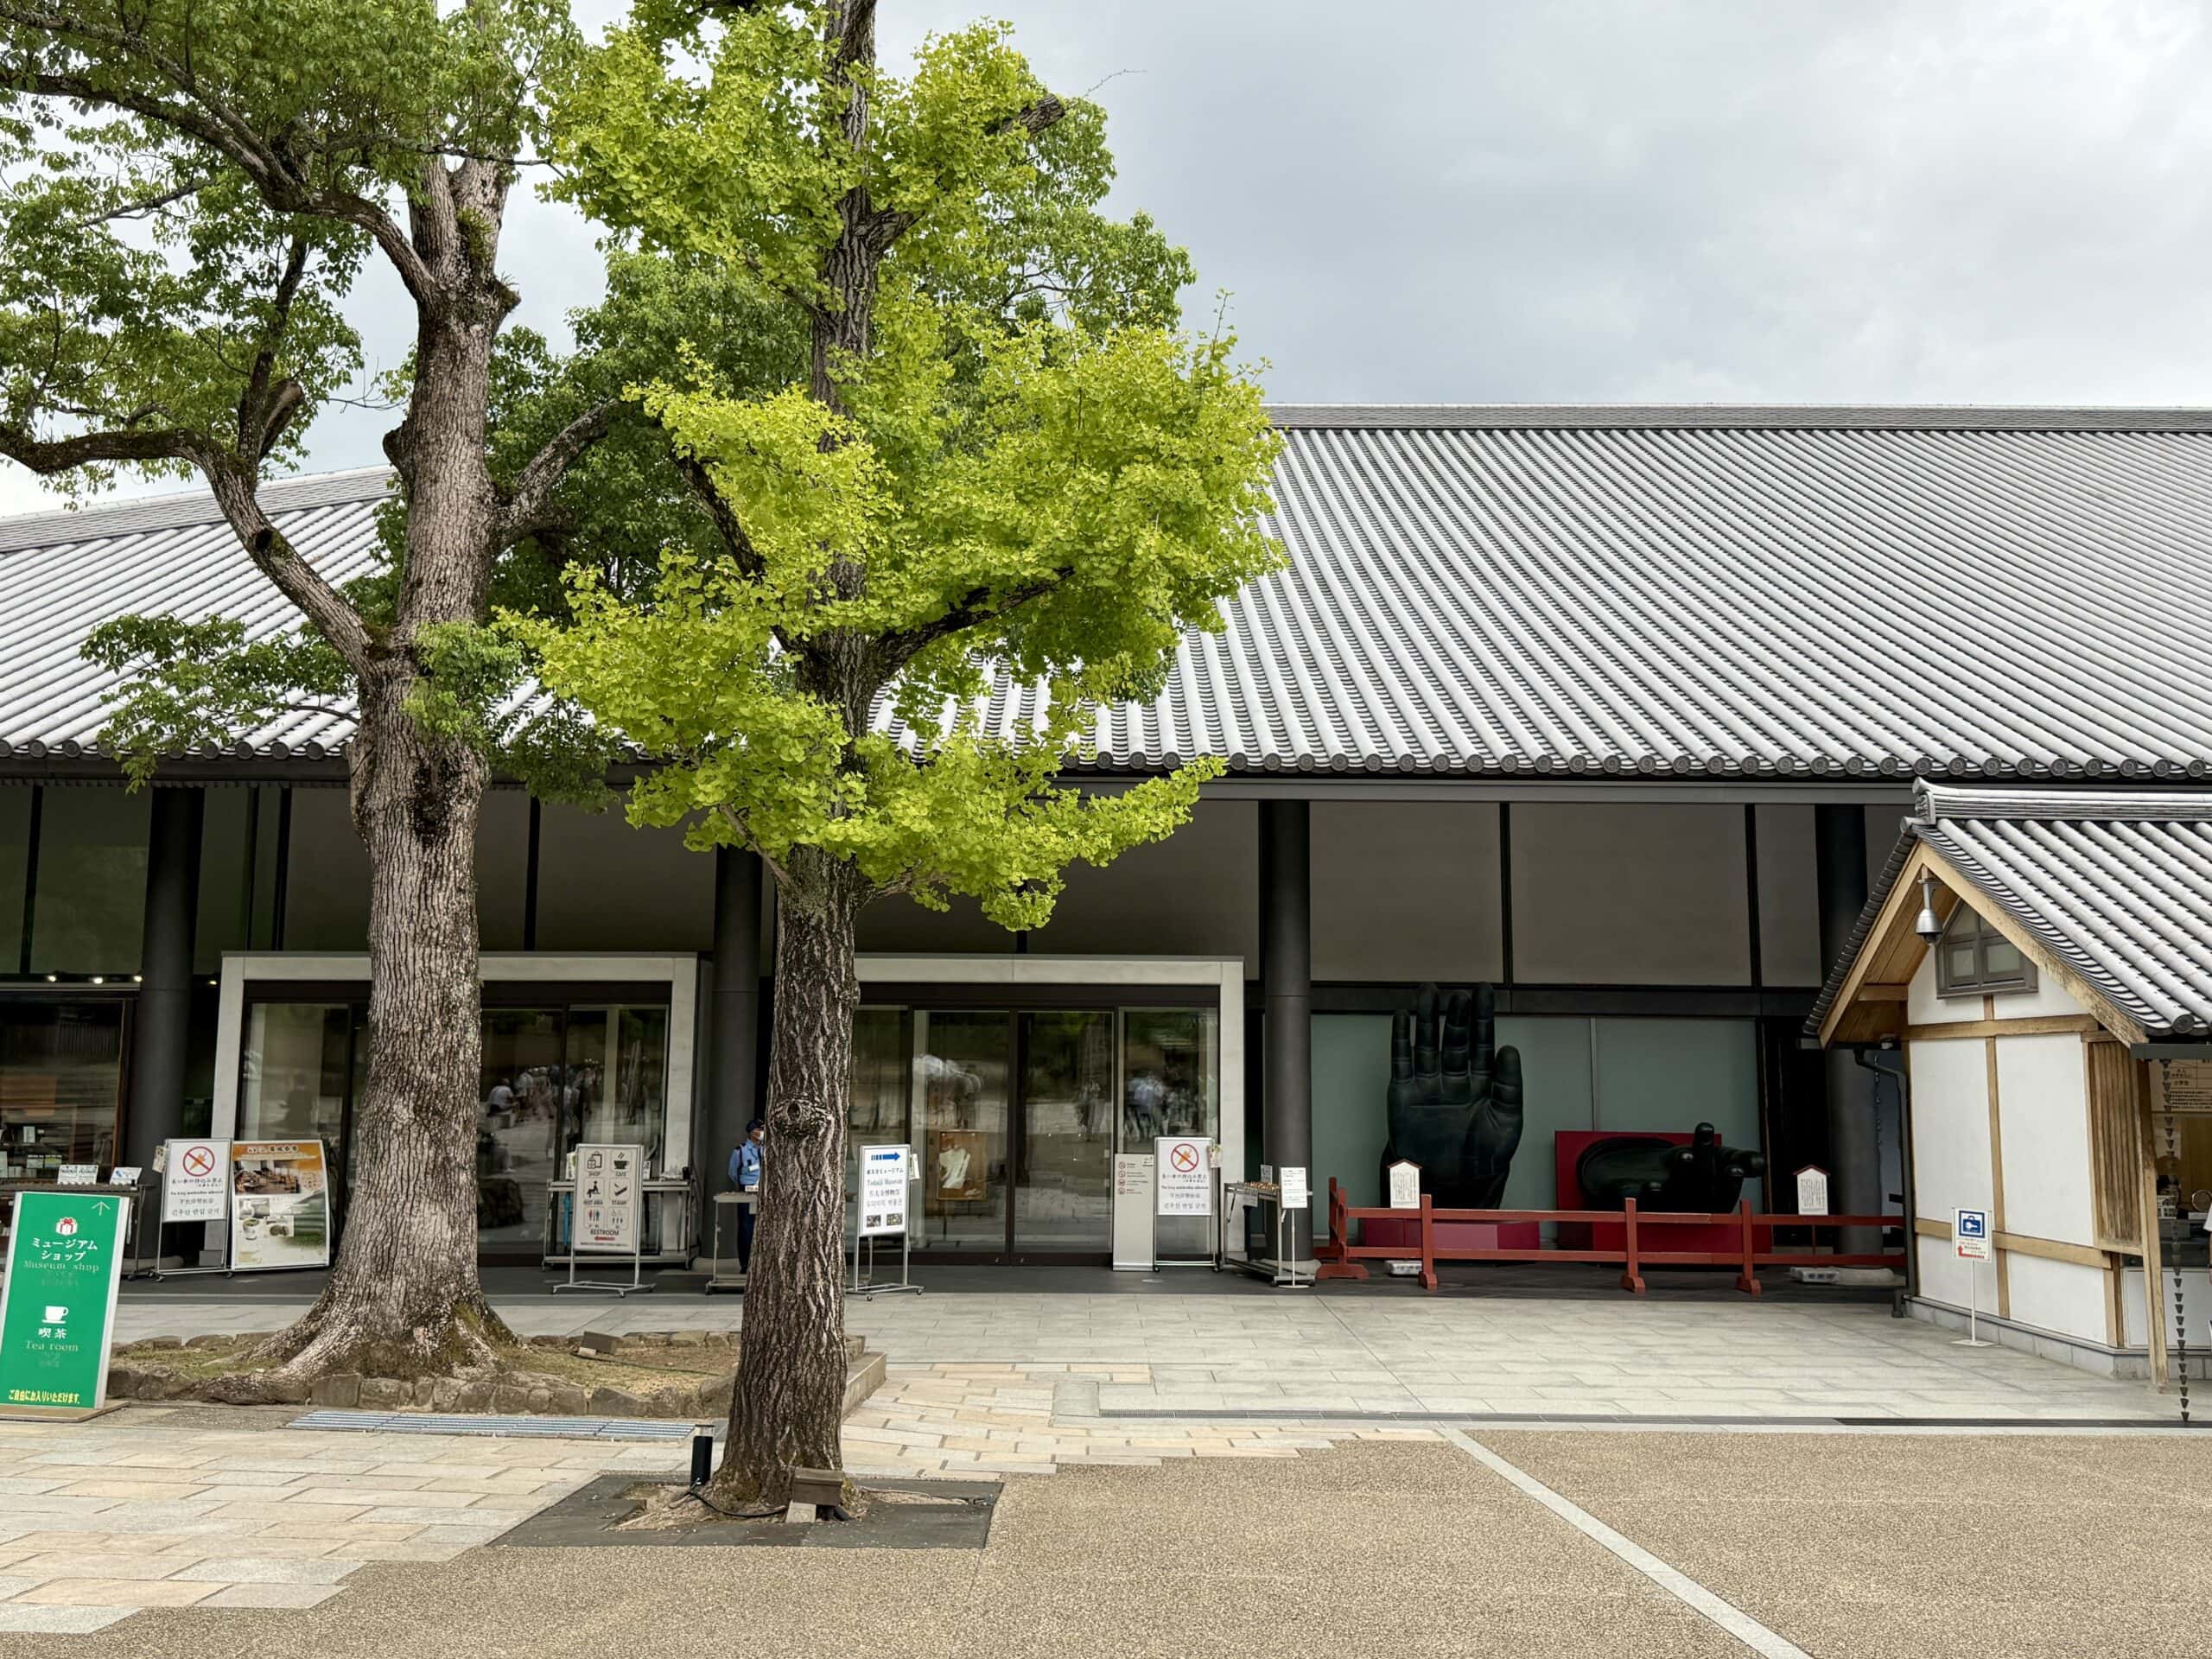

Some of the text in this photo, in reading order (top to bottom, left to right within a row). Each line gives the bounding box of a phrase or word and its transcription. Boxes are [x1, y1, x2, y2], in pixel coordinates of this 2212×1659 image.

[32, 1237, 98, 1250] ミュージアム
[41, 1250, 86, 1262] ショップ
[22, 1260, 99, 1274] Museum shop
[38, 1327, 67, 1339] 喫茶
[25, 1340, 79, 1352] Tea room
